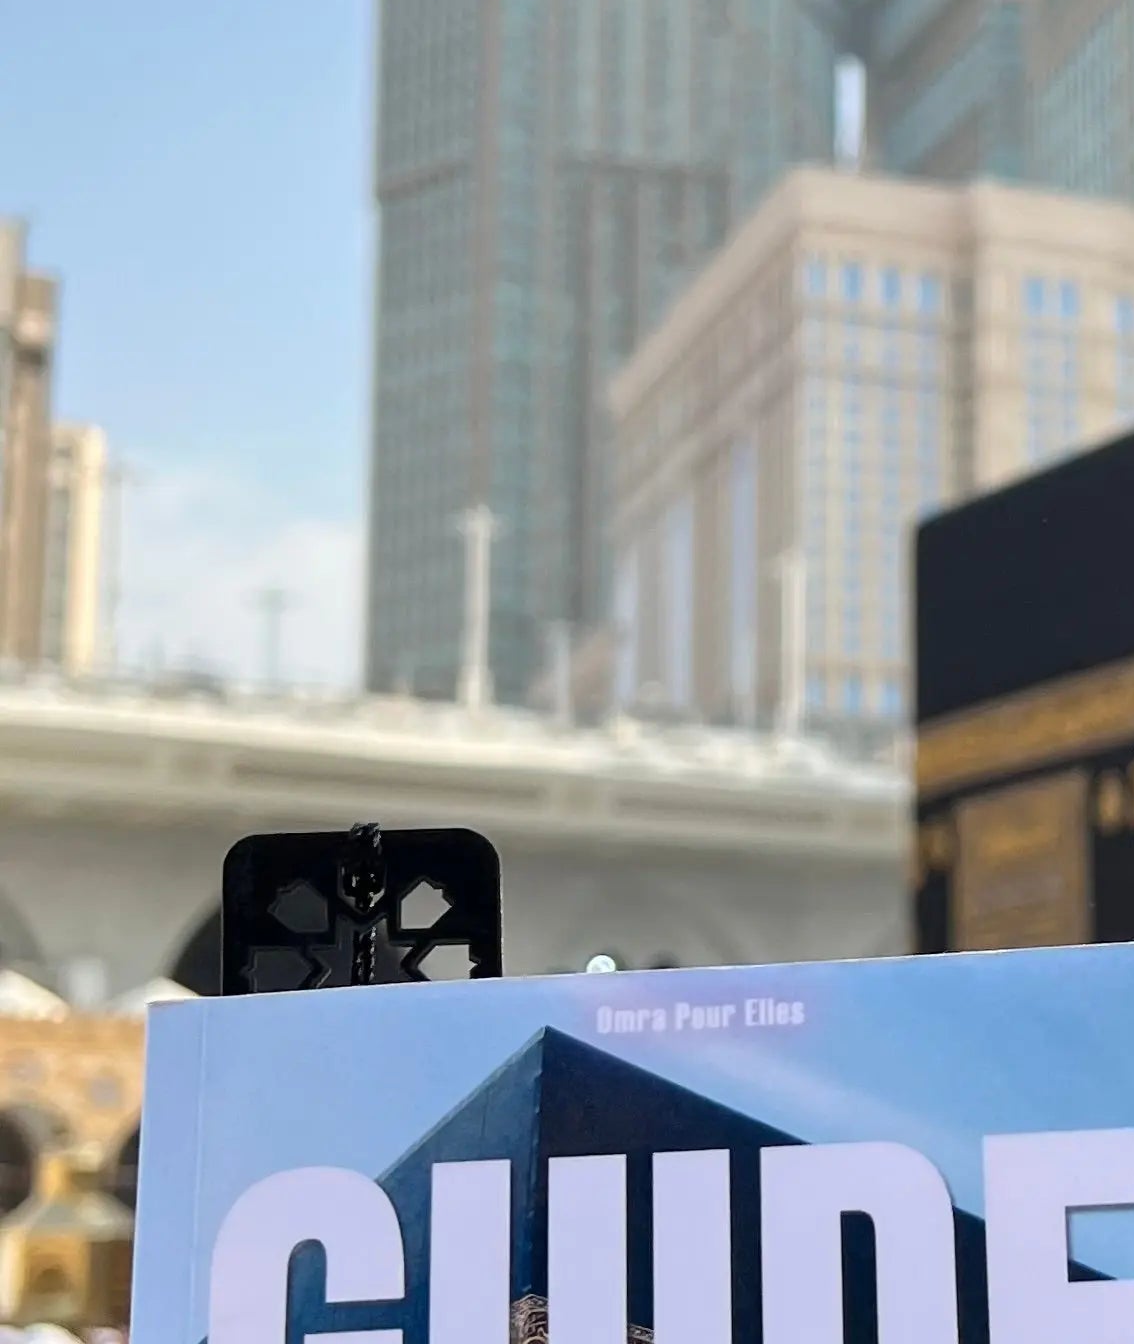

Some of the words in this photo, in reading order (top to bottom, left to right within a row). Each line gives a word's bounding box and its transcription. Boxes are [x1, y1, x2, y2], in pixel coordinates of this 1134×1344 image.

[596, 1005, 667, 1035] Omra
[674, 1001, 737, 1031] Pour
[744, 997, 806, 1027] Elles
